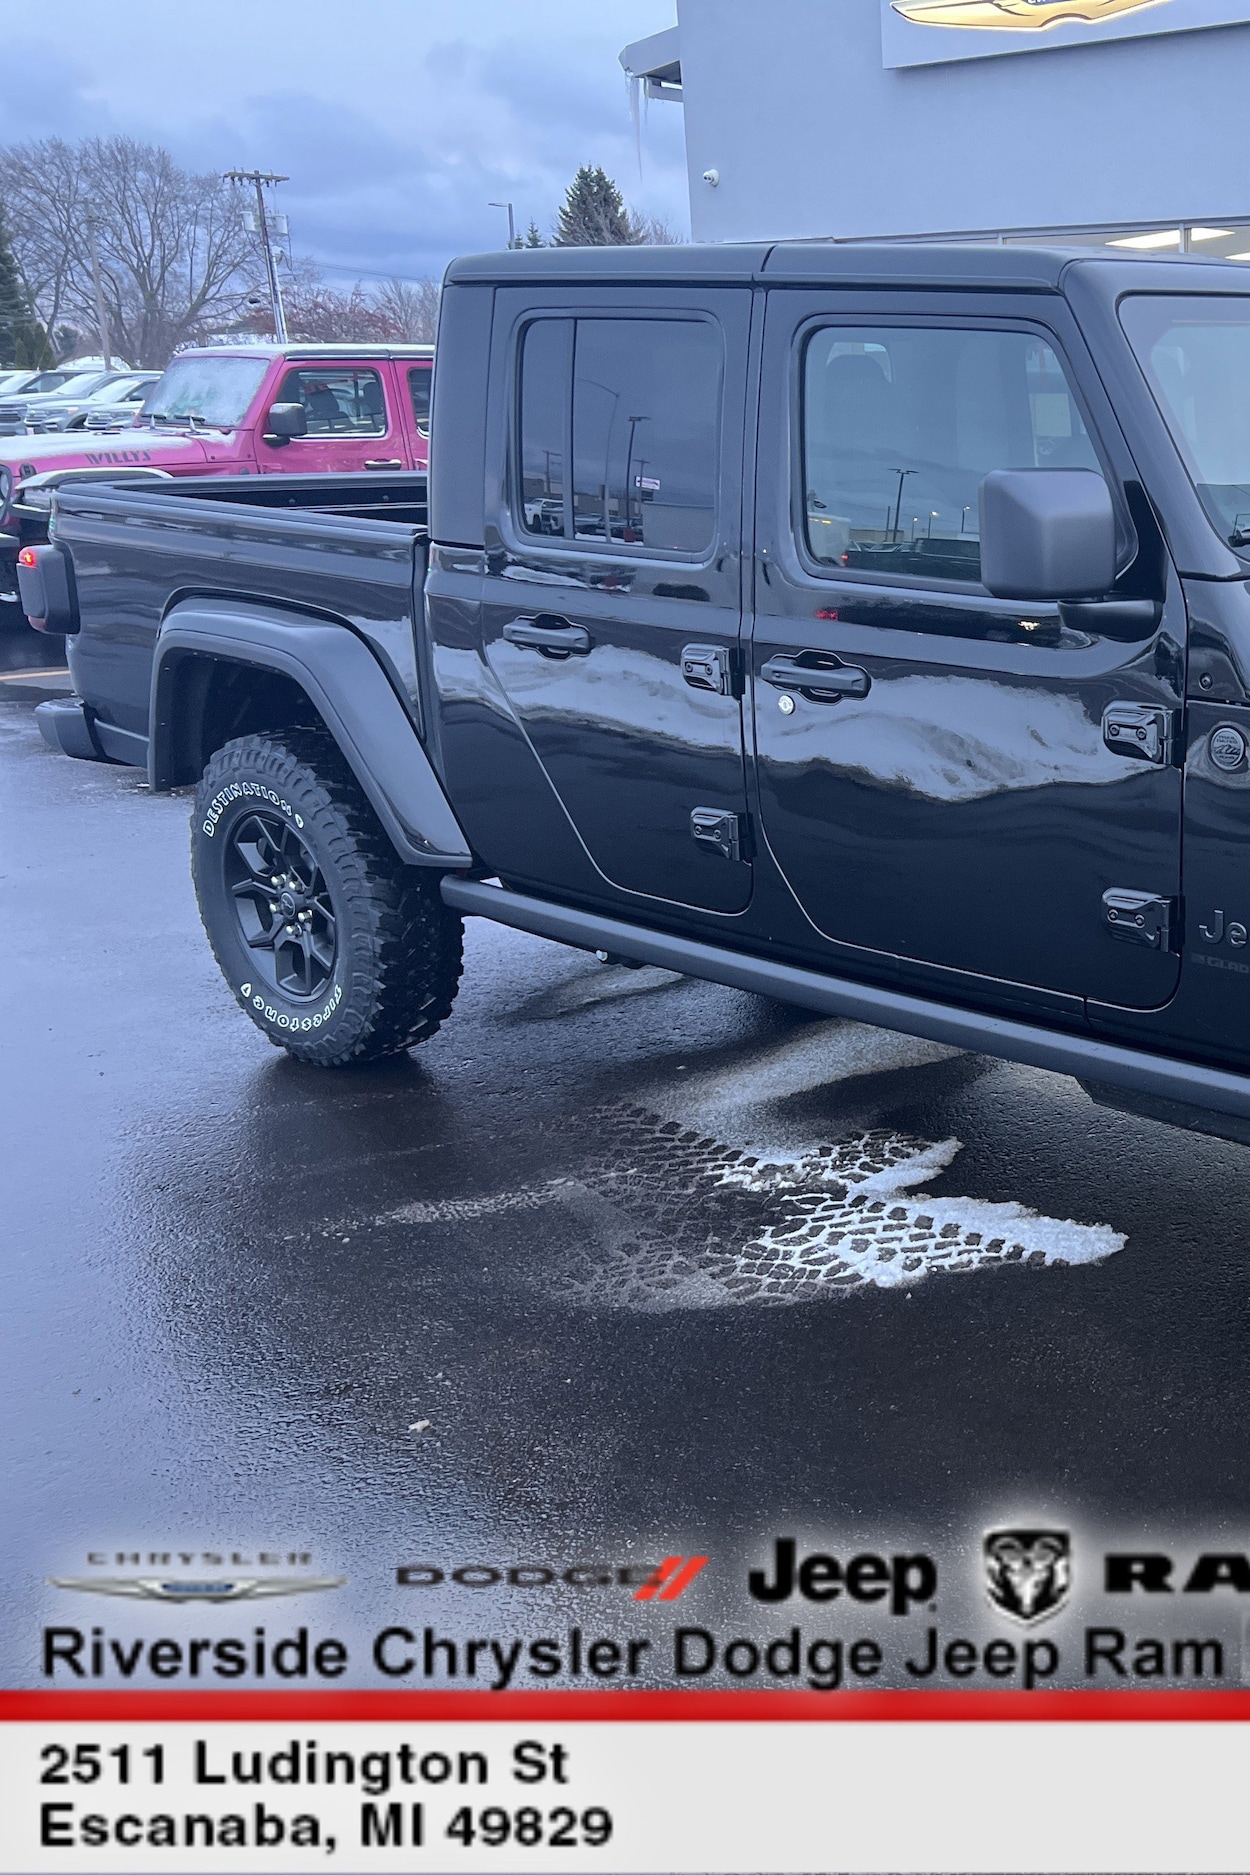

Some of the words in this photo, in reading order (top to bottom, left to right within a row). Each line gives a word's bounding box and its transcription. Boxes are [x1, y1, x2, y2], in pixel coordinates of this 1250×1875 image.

[84, 449, 152, 465] WILLYS
[202, 780, 294, 838] DESTINATION
[252, 983, 343, 1032] Firestone
